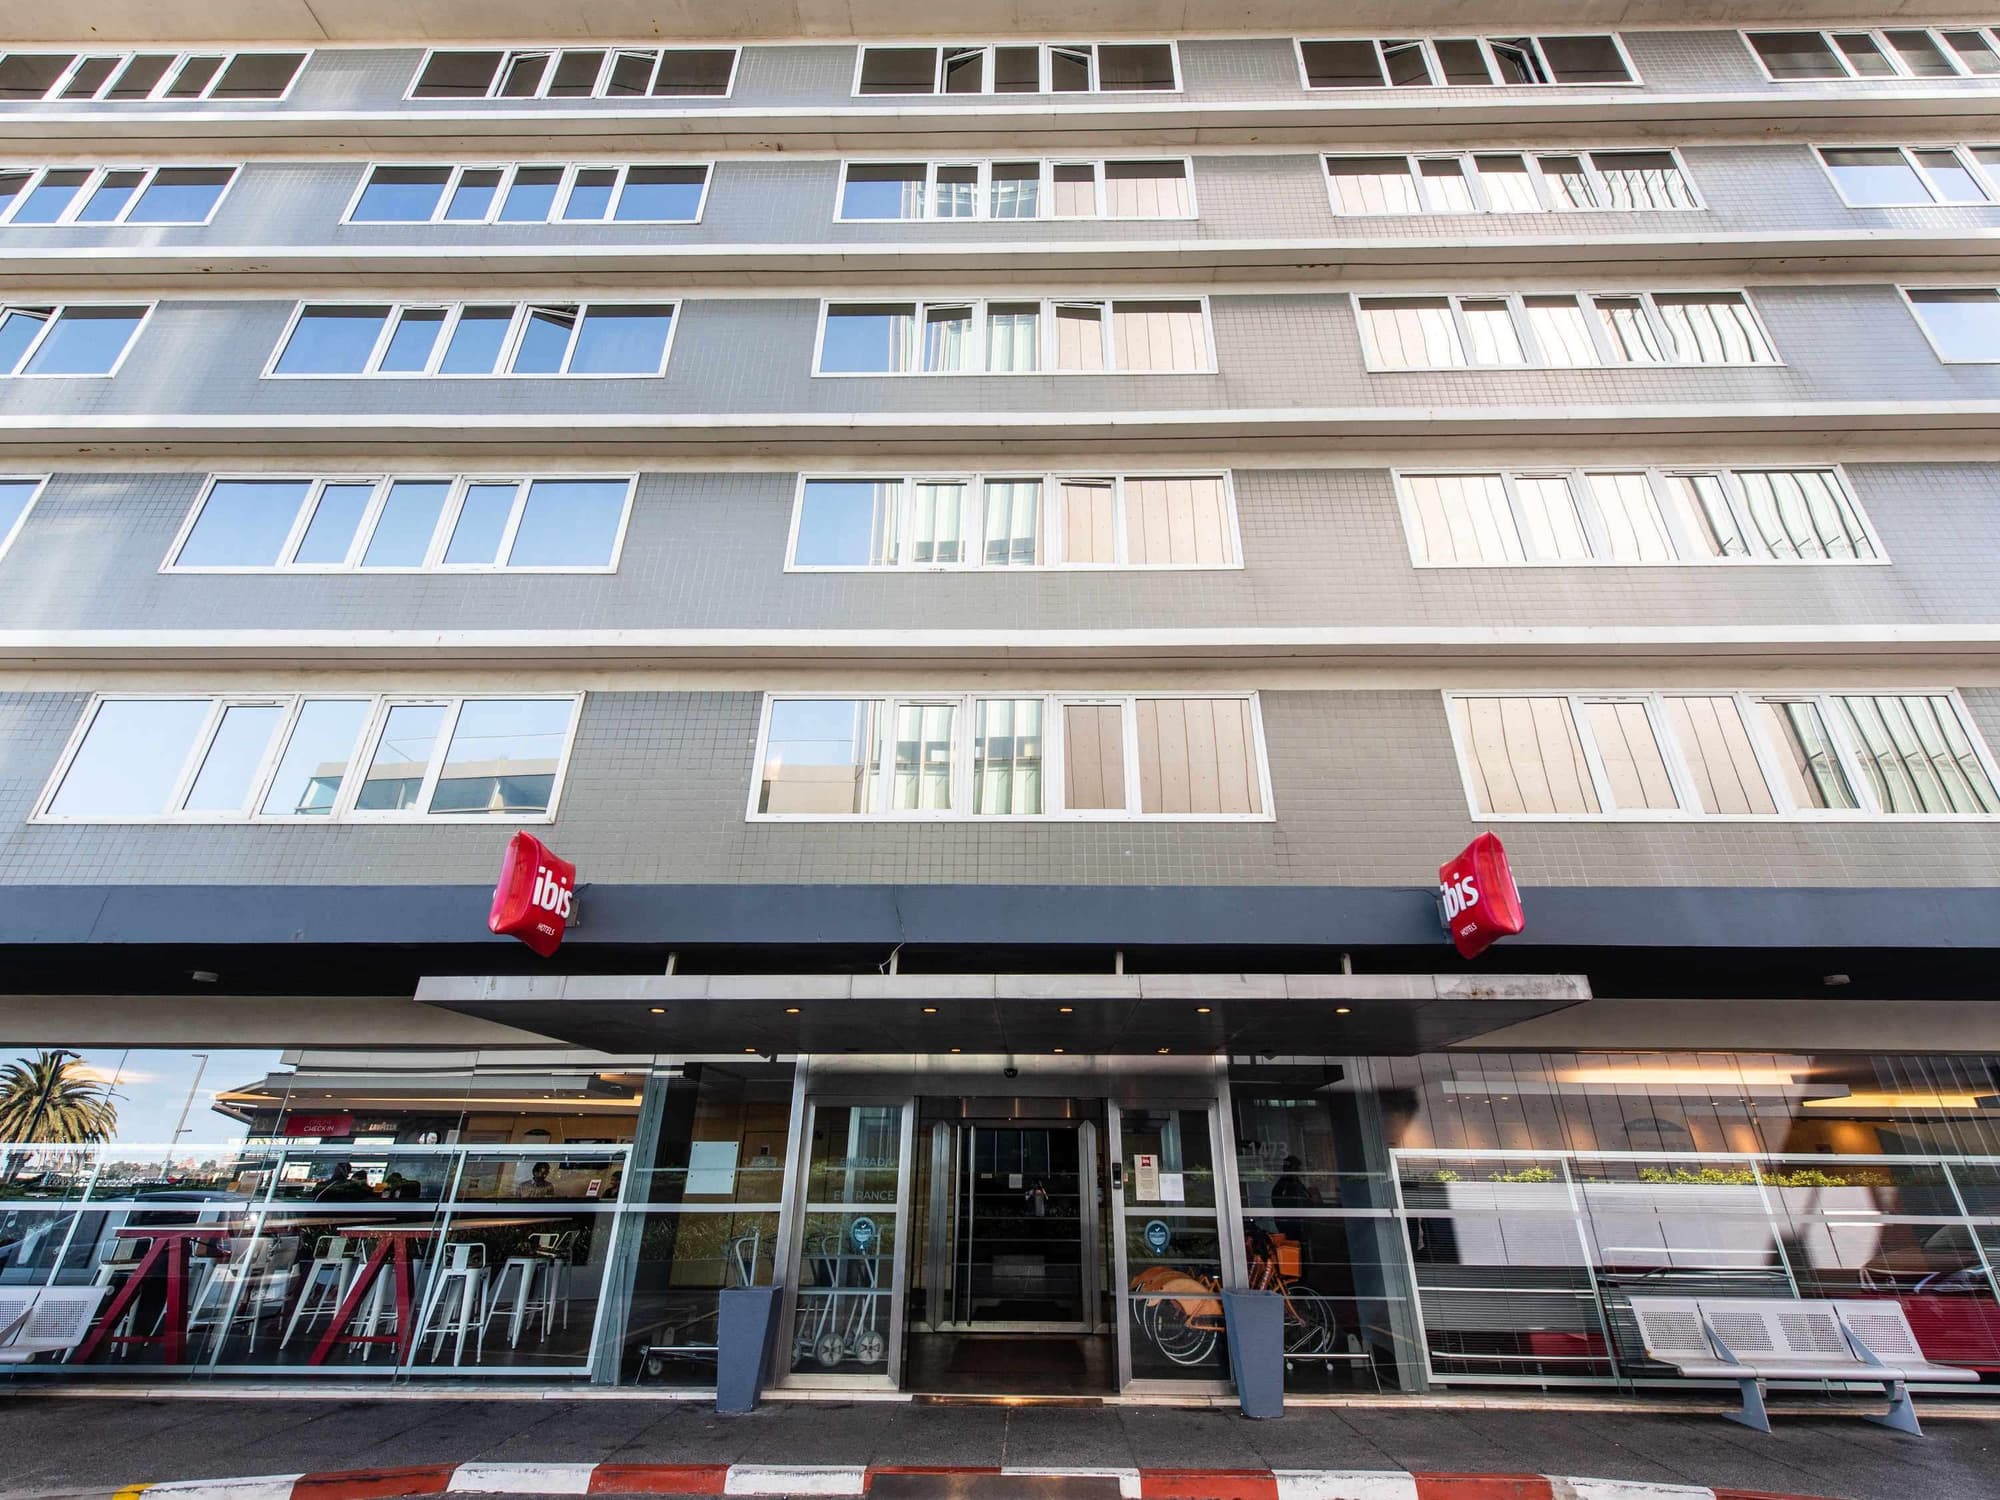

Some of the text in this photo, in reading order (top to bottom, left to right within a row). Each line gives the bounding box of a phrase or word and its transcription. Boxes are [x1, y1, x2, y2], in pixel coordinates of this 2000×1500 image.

[532, 866, 573, 919] ibis
[1440, 872, 1479, 922] ibis
[536, 922, 556, 936] HOTELS
[1460, 922, 1478, 937] HOTELS
[840, 1157, 896, 1167] ERADA
[833, 1190, 896, 1201] ERANCE
